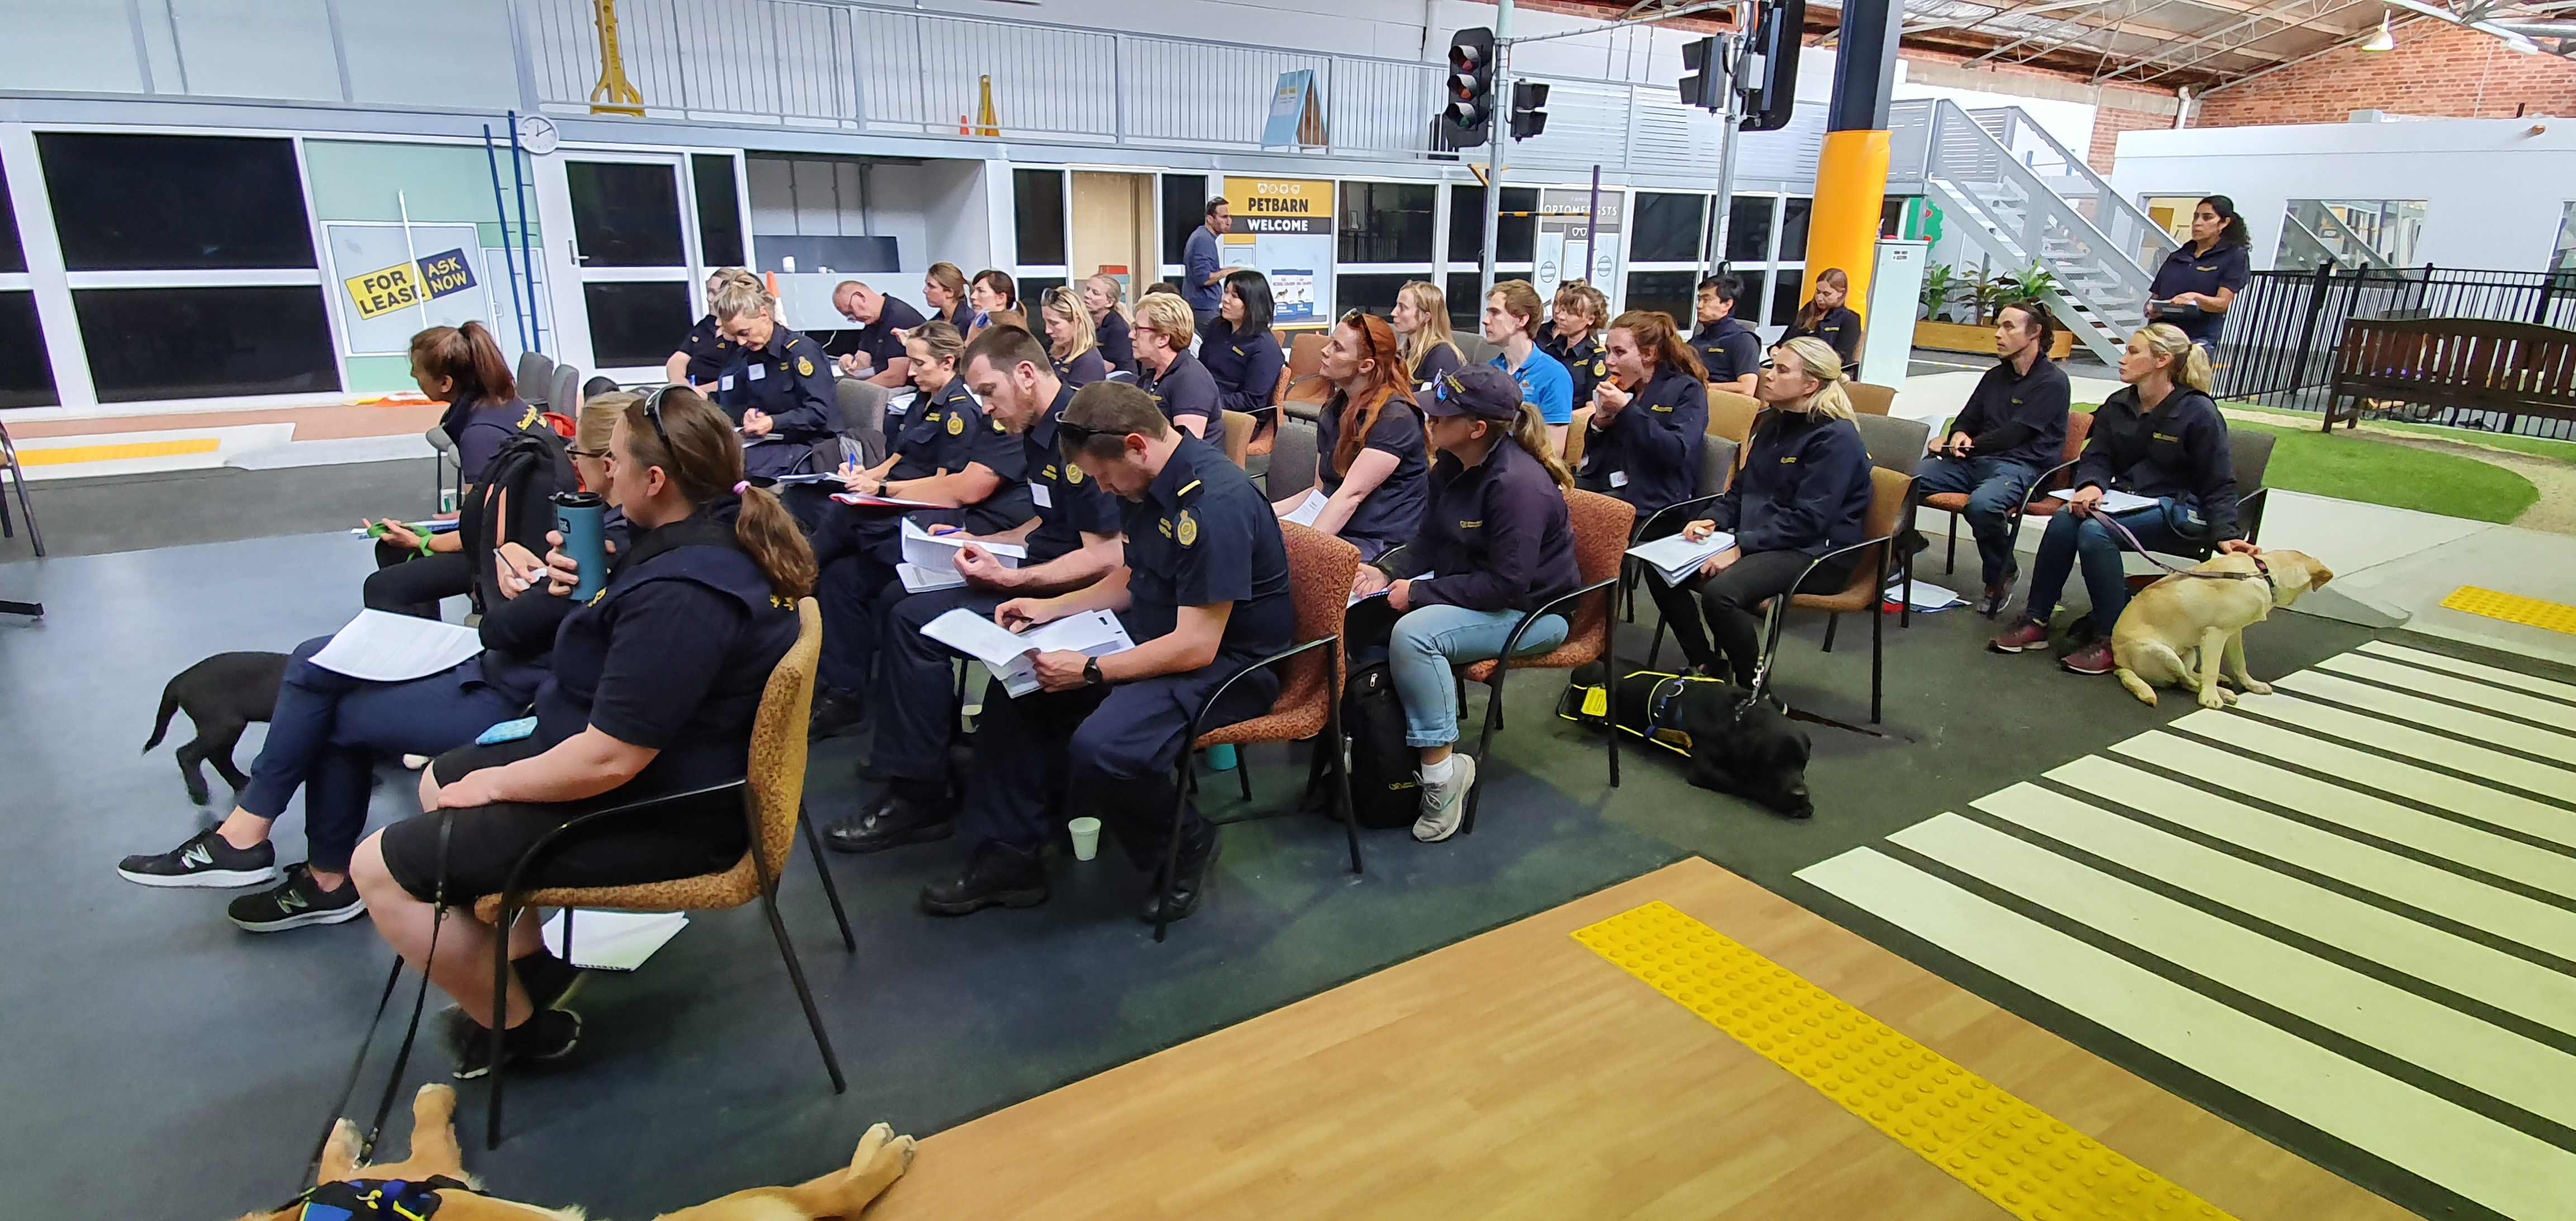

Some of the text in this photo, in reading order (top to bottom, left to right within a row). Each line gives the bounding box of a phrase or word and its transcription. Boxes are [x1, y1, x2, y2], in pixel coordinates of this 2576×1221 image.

[1248, 197, 1309, 212] PETBARN
[1544, 205, 1617, 216] OPTOMETISTS
[1247, 219, 1309, 231] WELCOME
[428, 257, 462, 278] ASK
[363, 271, 408, 294] FOR
[430, 271, 467, 294] NOW
